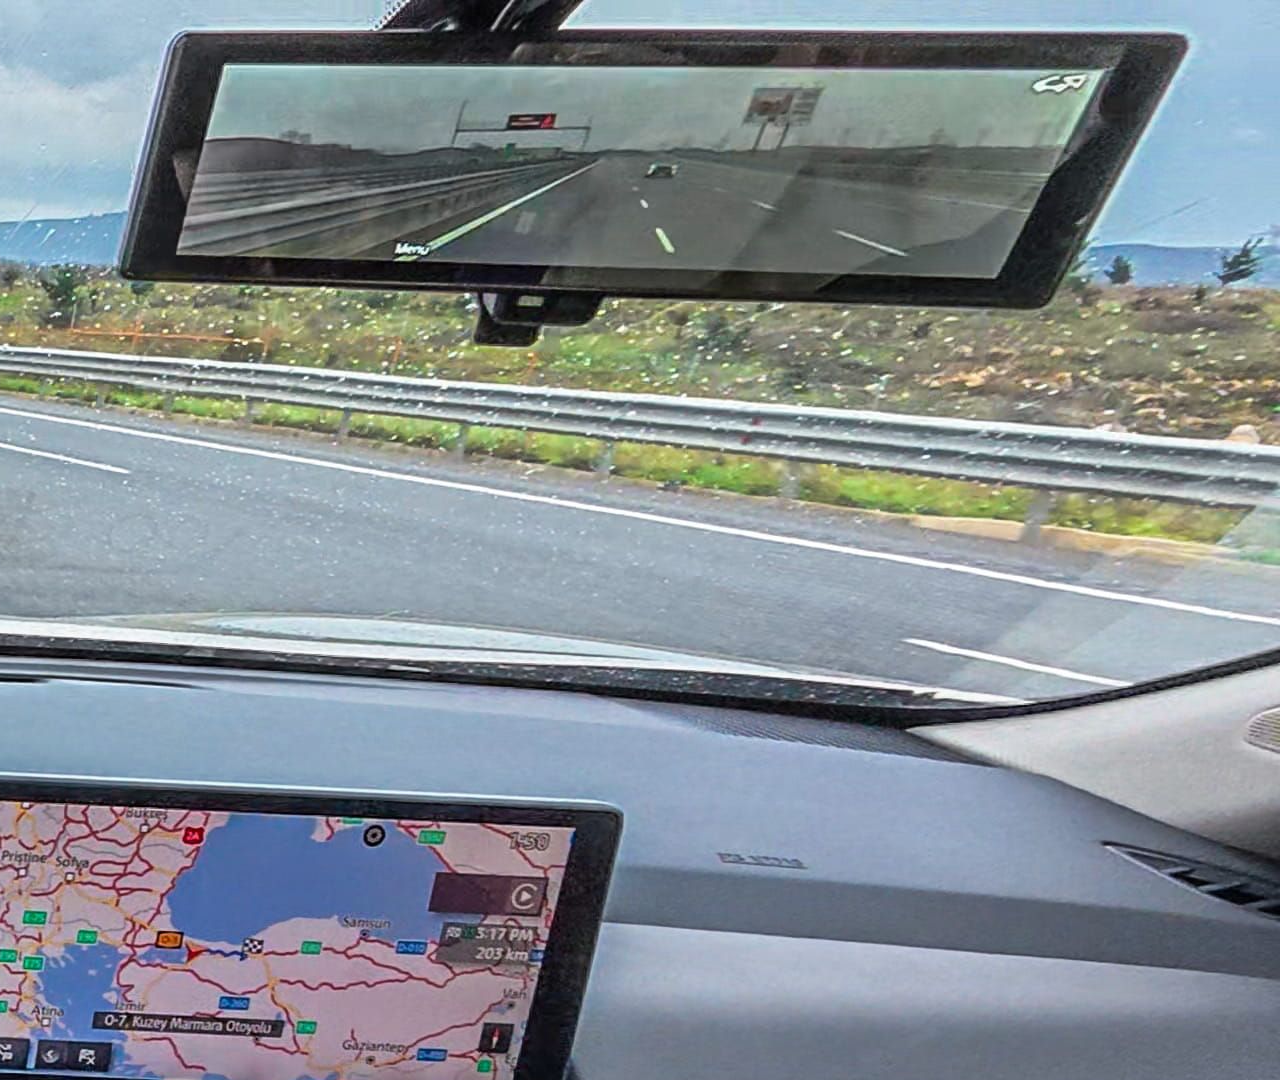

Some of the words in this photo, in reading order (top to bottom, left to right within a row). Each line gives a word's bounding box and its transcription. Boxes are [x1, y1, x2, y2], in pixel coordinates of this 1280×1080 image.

[56, 856, 89, 869] Sofya
[342, 916, 391, 928] Samsun
[509, 929, 534, 942] PM
[476, 947, 503, 960] 203
[506, 948, 529, 960] km
[502, 988, 527, 999] Van
[32, 1006, 64, 1016] Atina
[132, 1016, 166, 1031] Kuzey
[170, 1018, 222, 1031] Marmara
[226, 1020, 272, 1034] Otoyolu
[342, 1040, 406, 1055] Gaziantep
